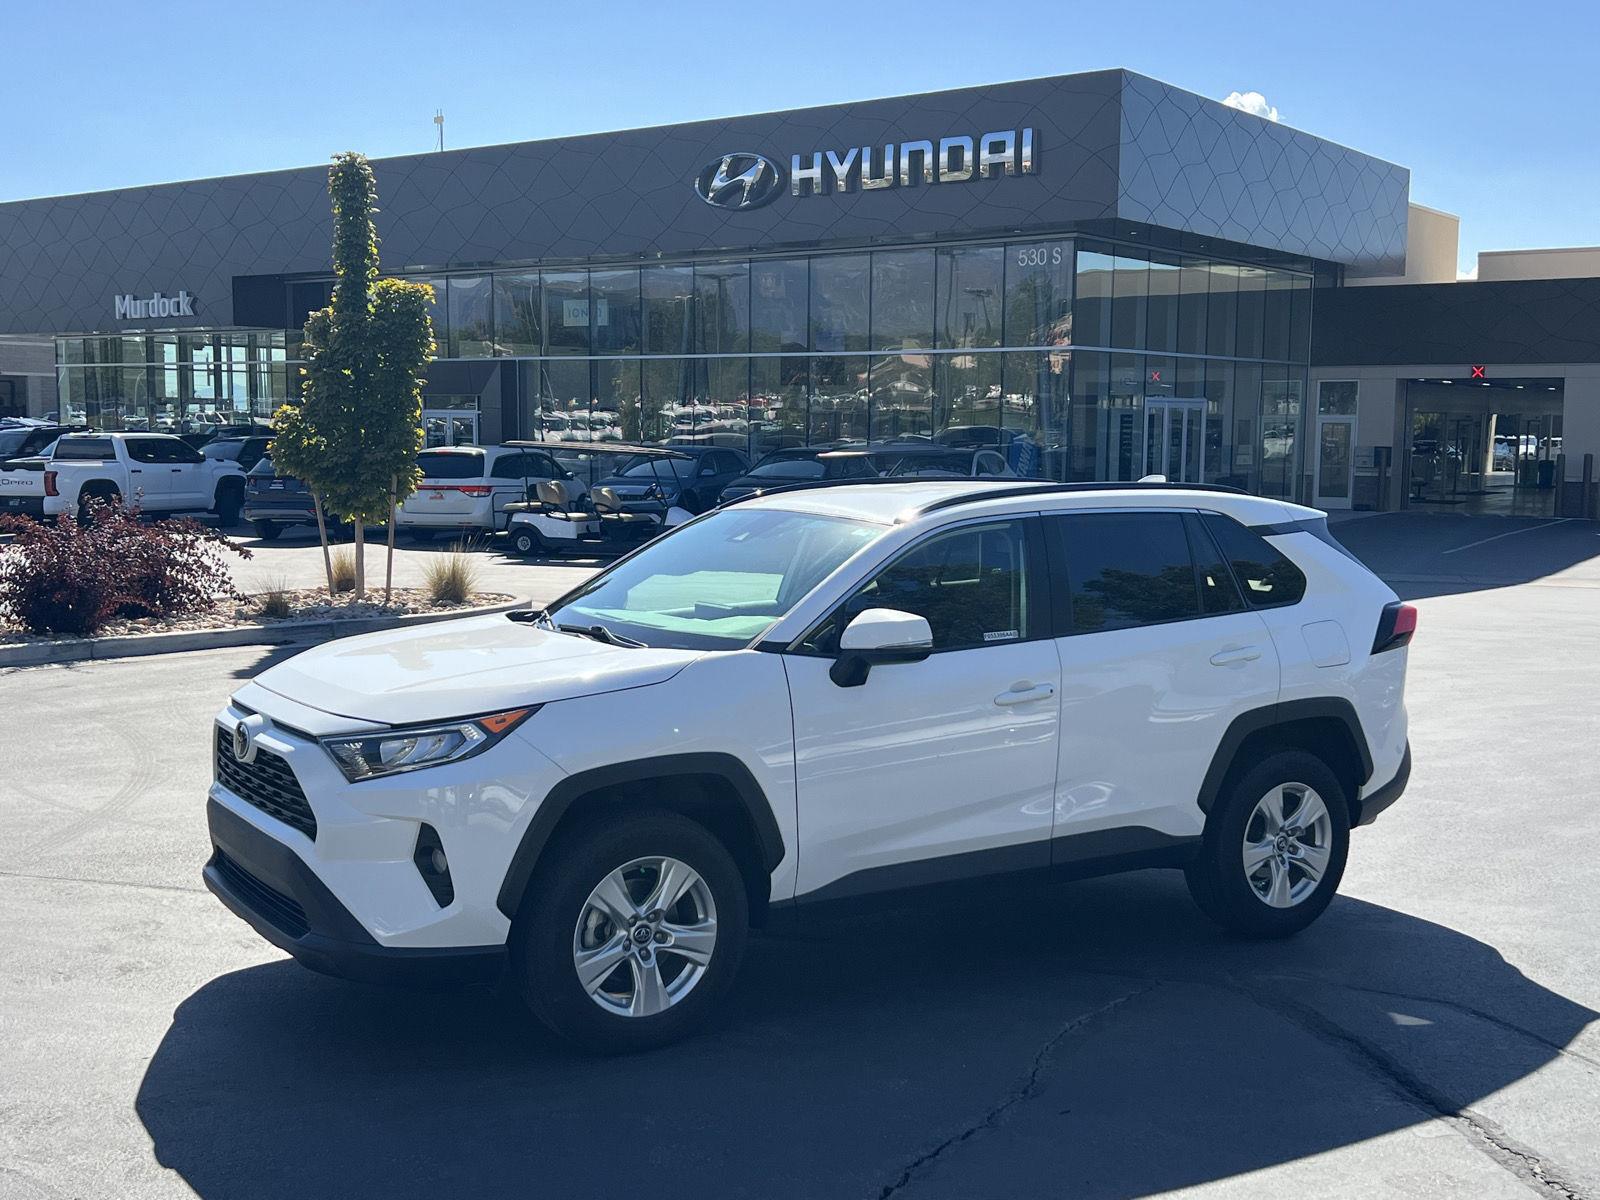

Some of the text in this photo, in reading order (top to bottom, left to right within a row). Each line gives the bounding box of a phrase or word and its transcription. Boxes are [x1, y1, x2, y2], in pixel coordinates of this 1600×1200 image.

[791, 127, 1034, 196] HYUNDAI
[1018, 247, 1062, 266] 530 S
[114, 290, 195, 320] Murdock
